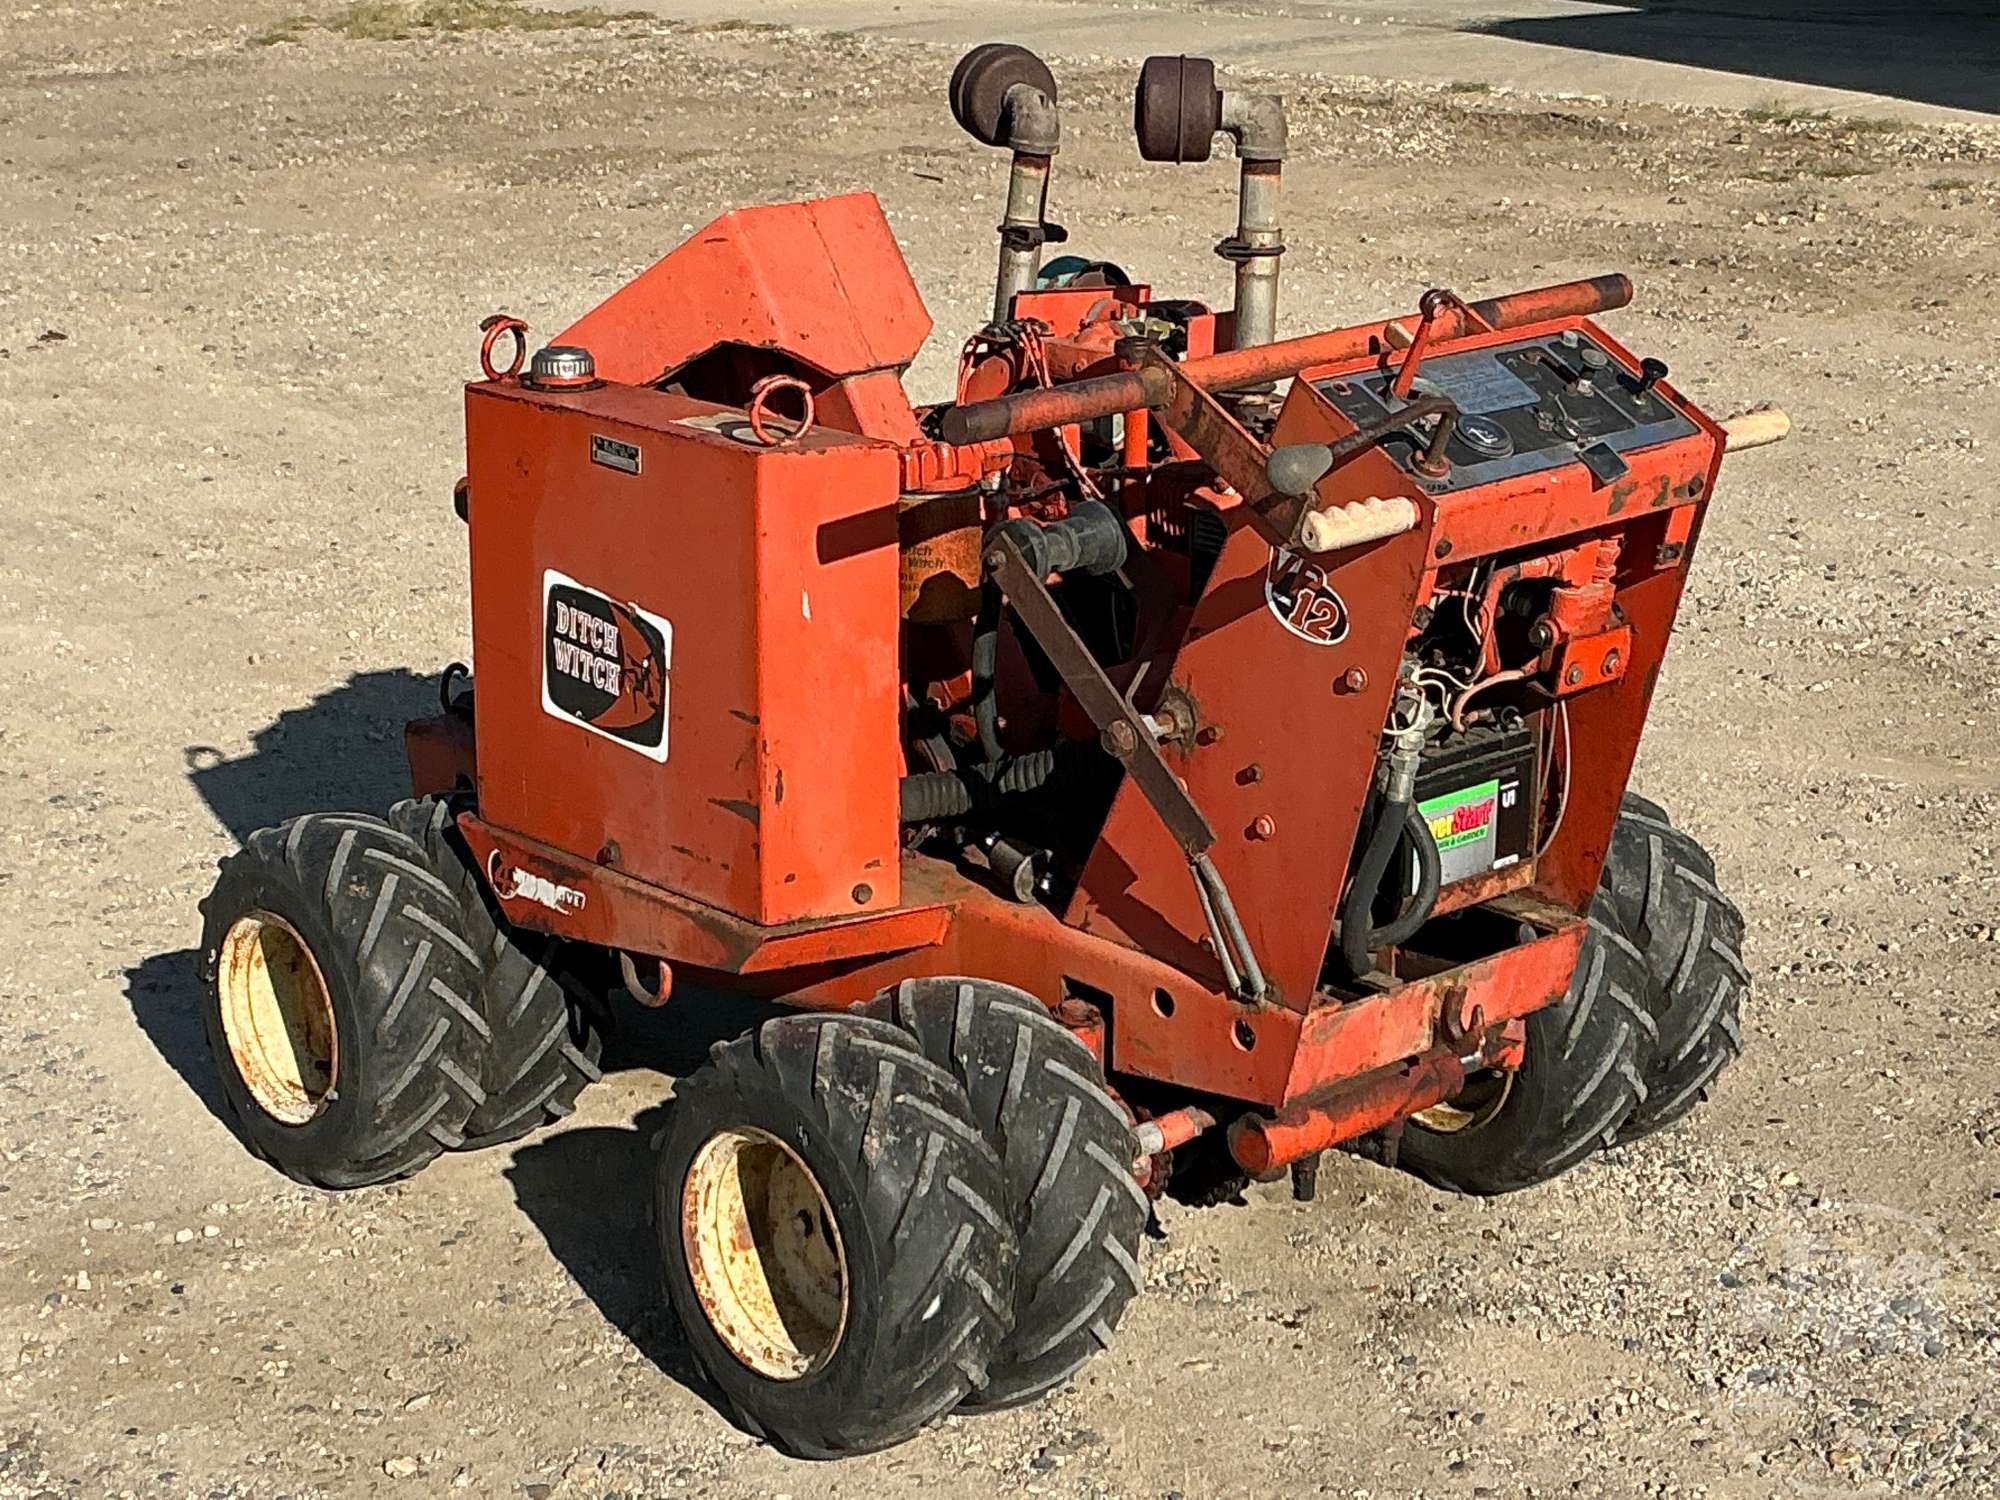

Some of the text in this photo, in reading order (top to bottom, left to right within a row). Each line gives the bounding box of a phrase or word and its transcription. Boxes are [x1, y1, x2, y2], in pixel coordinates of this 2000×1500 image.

[555, 601, 619, 658] DITCH
[1287, 588, 1340, 641] 12
[552, 637, 620, 696] WITCH
[1425, 799, 1494, 839] verStart
